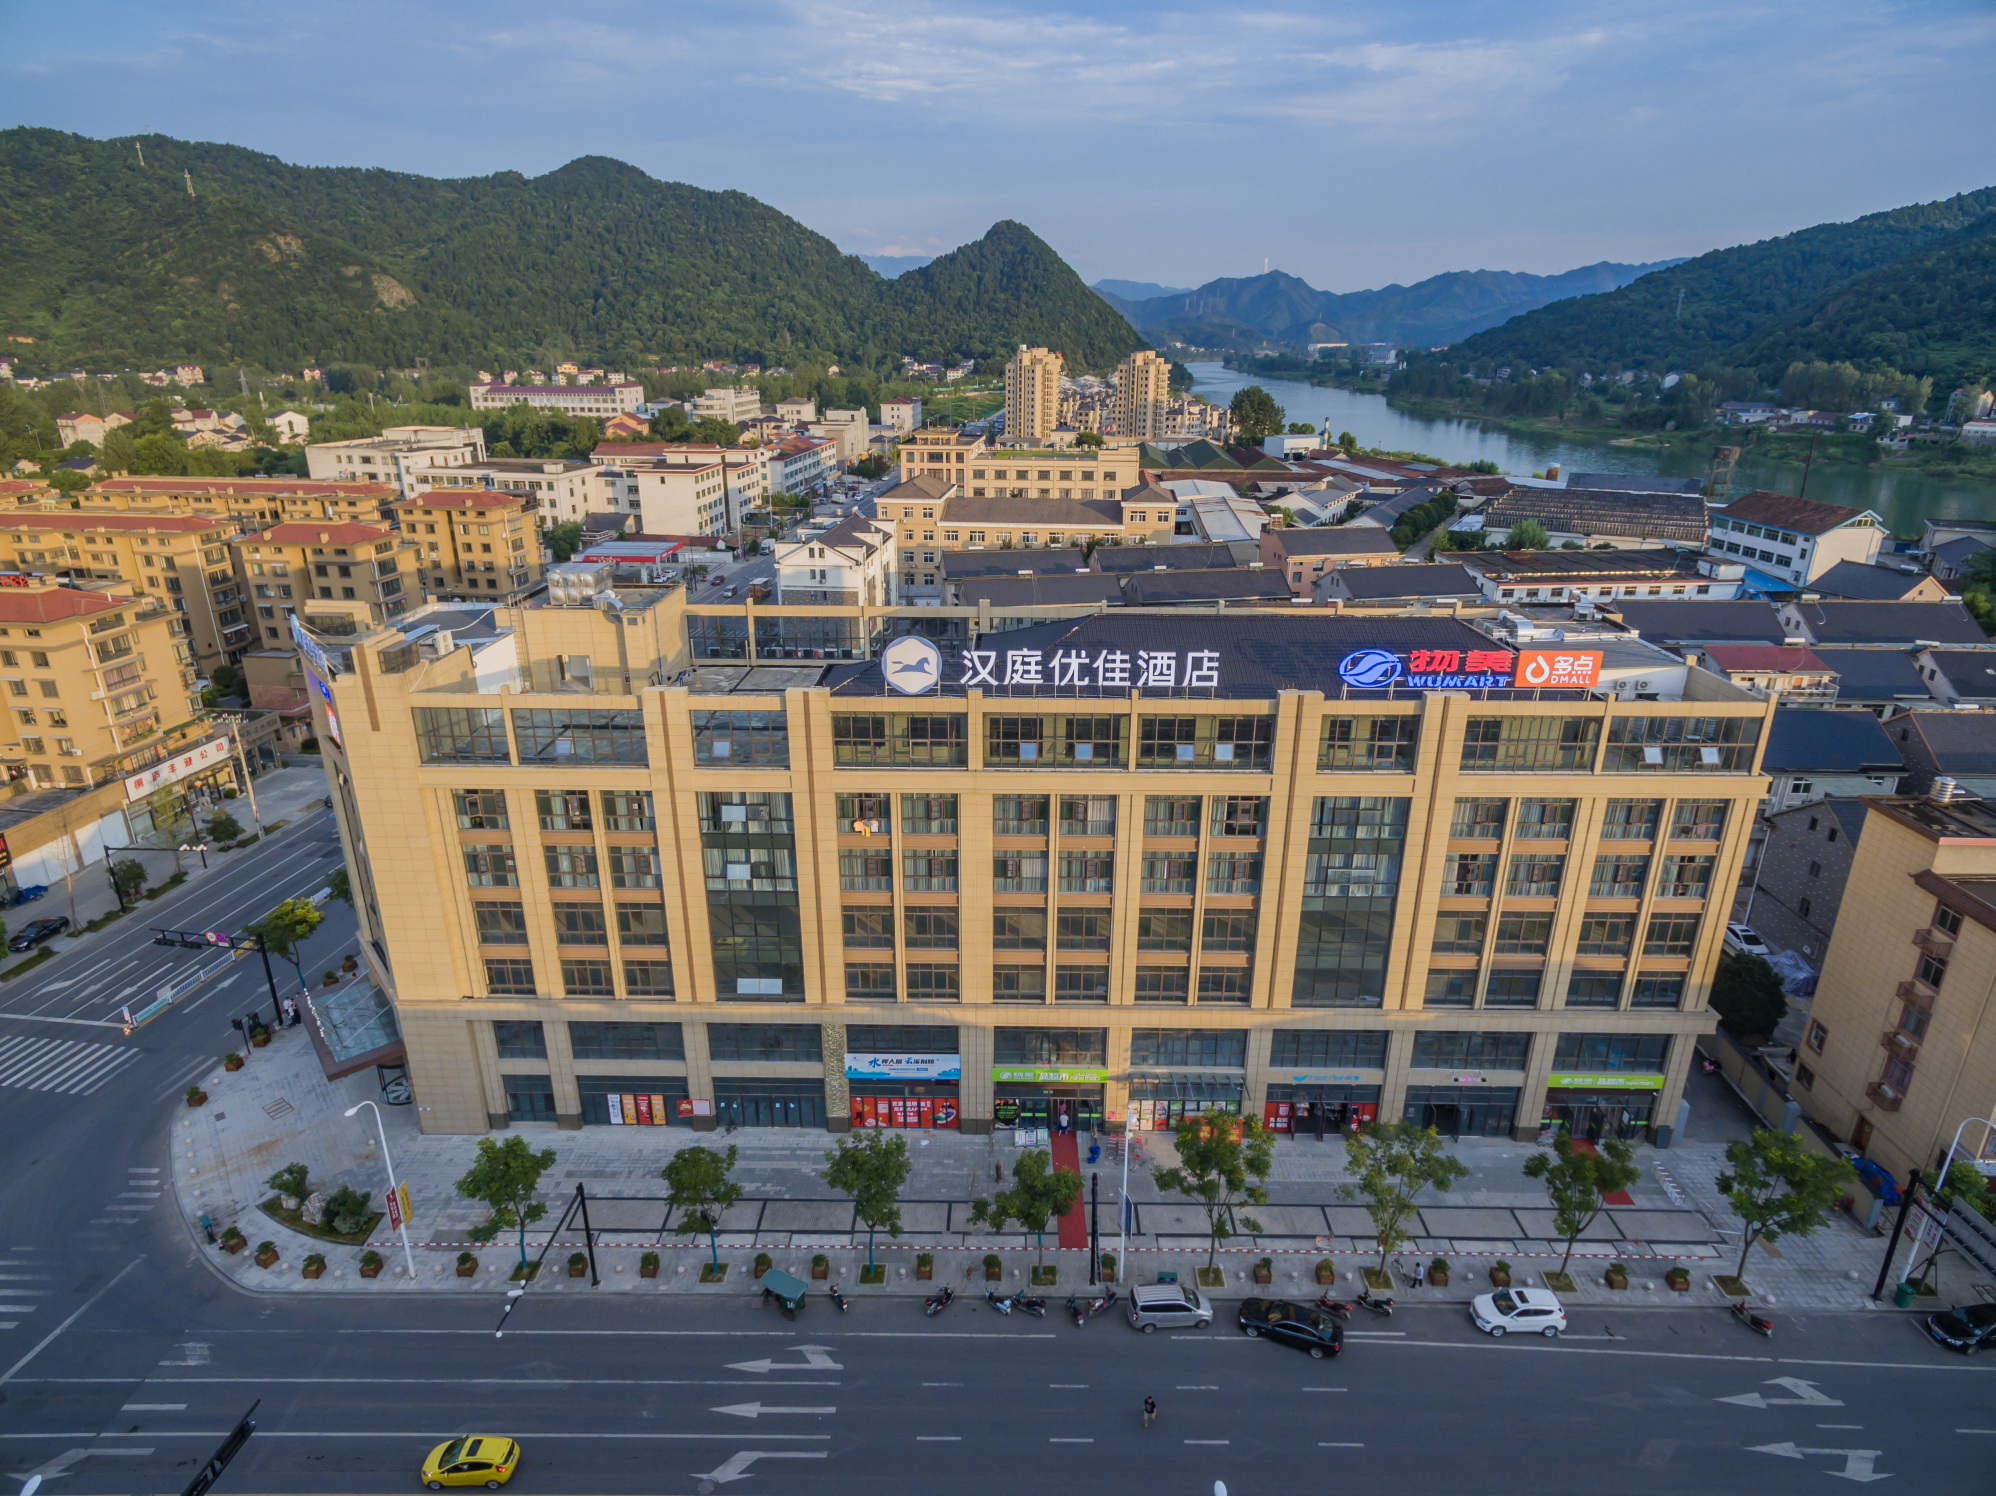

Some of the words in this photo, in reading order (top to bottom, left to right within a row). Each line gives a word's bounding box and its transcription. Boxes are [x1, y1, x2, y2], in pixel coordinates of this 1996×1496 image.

[959, 648, 1220, 687] 汉庭优佳酒店
[1409, 650, 1513, 673] 物美
[1552, 655, 1594, 675] 多点
[1406, 674, 1510, 688] WUMART
[1550, 675, 1591, 684] DMALL
